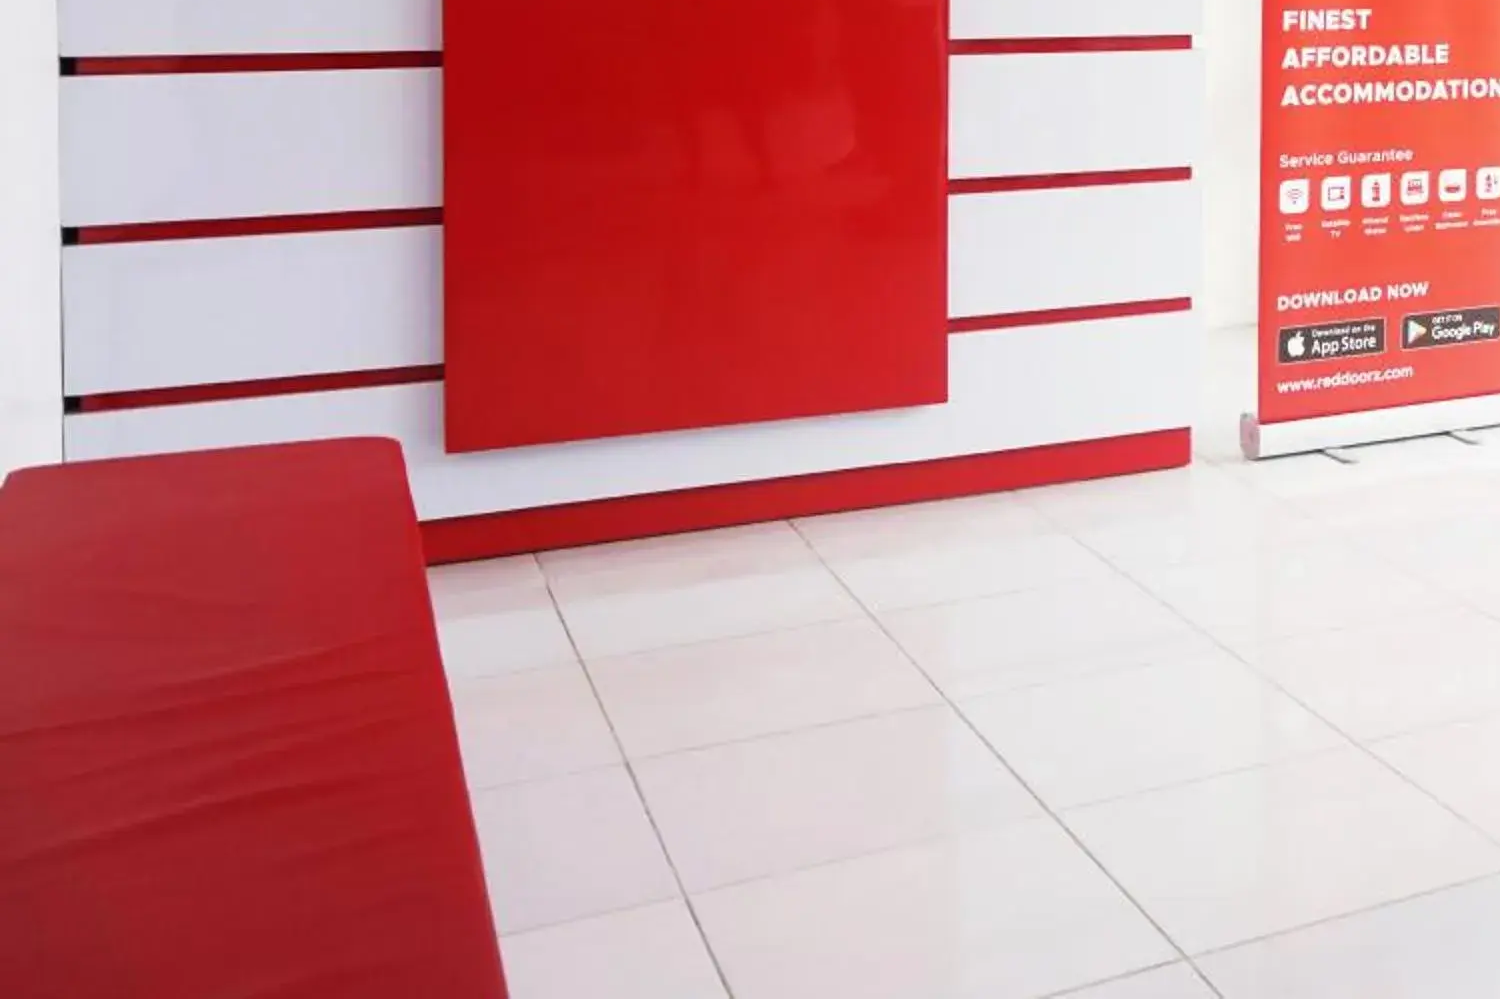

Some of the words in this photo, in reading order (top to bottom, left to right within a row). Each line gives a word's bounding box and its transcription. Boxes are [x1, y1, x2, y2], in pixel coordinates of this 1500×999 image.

[1282, 9, 1372, 31] FINEST
[1281, 44, 1449, 69] AFFORDABLE
[1279, 153, 1333, 169] Service
[1337, 148, 1414, 164] Guarantee
[1277, 286, 1383, 311] DOWNLOAD
[1387, 281, 1429, 301] NOW
[1311, 325, 1350, 338] Download
[1431, 324, 1472, 341] Google
[1473, 320, 1496, 337] Play
[1311, 339, 1340, 357] App
[1341, 336, 1377, 351] Store
[1277, 365, 1414, 394] www.reddoorz.com
